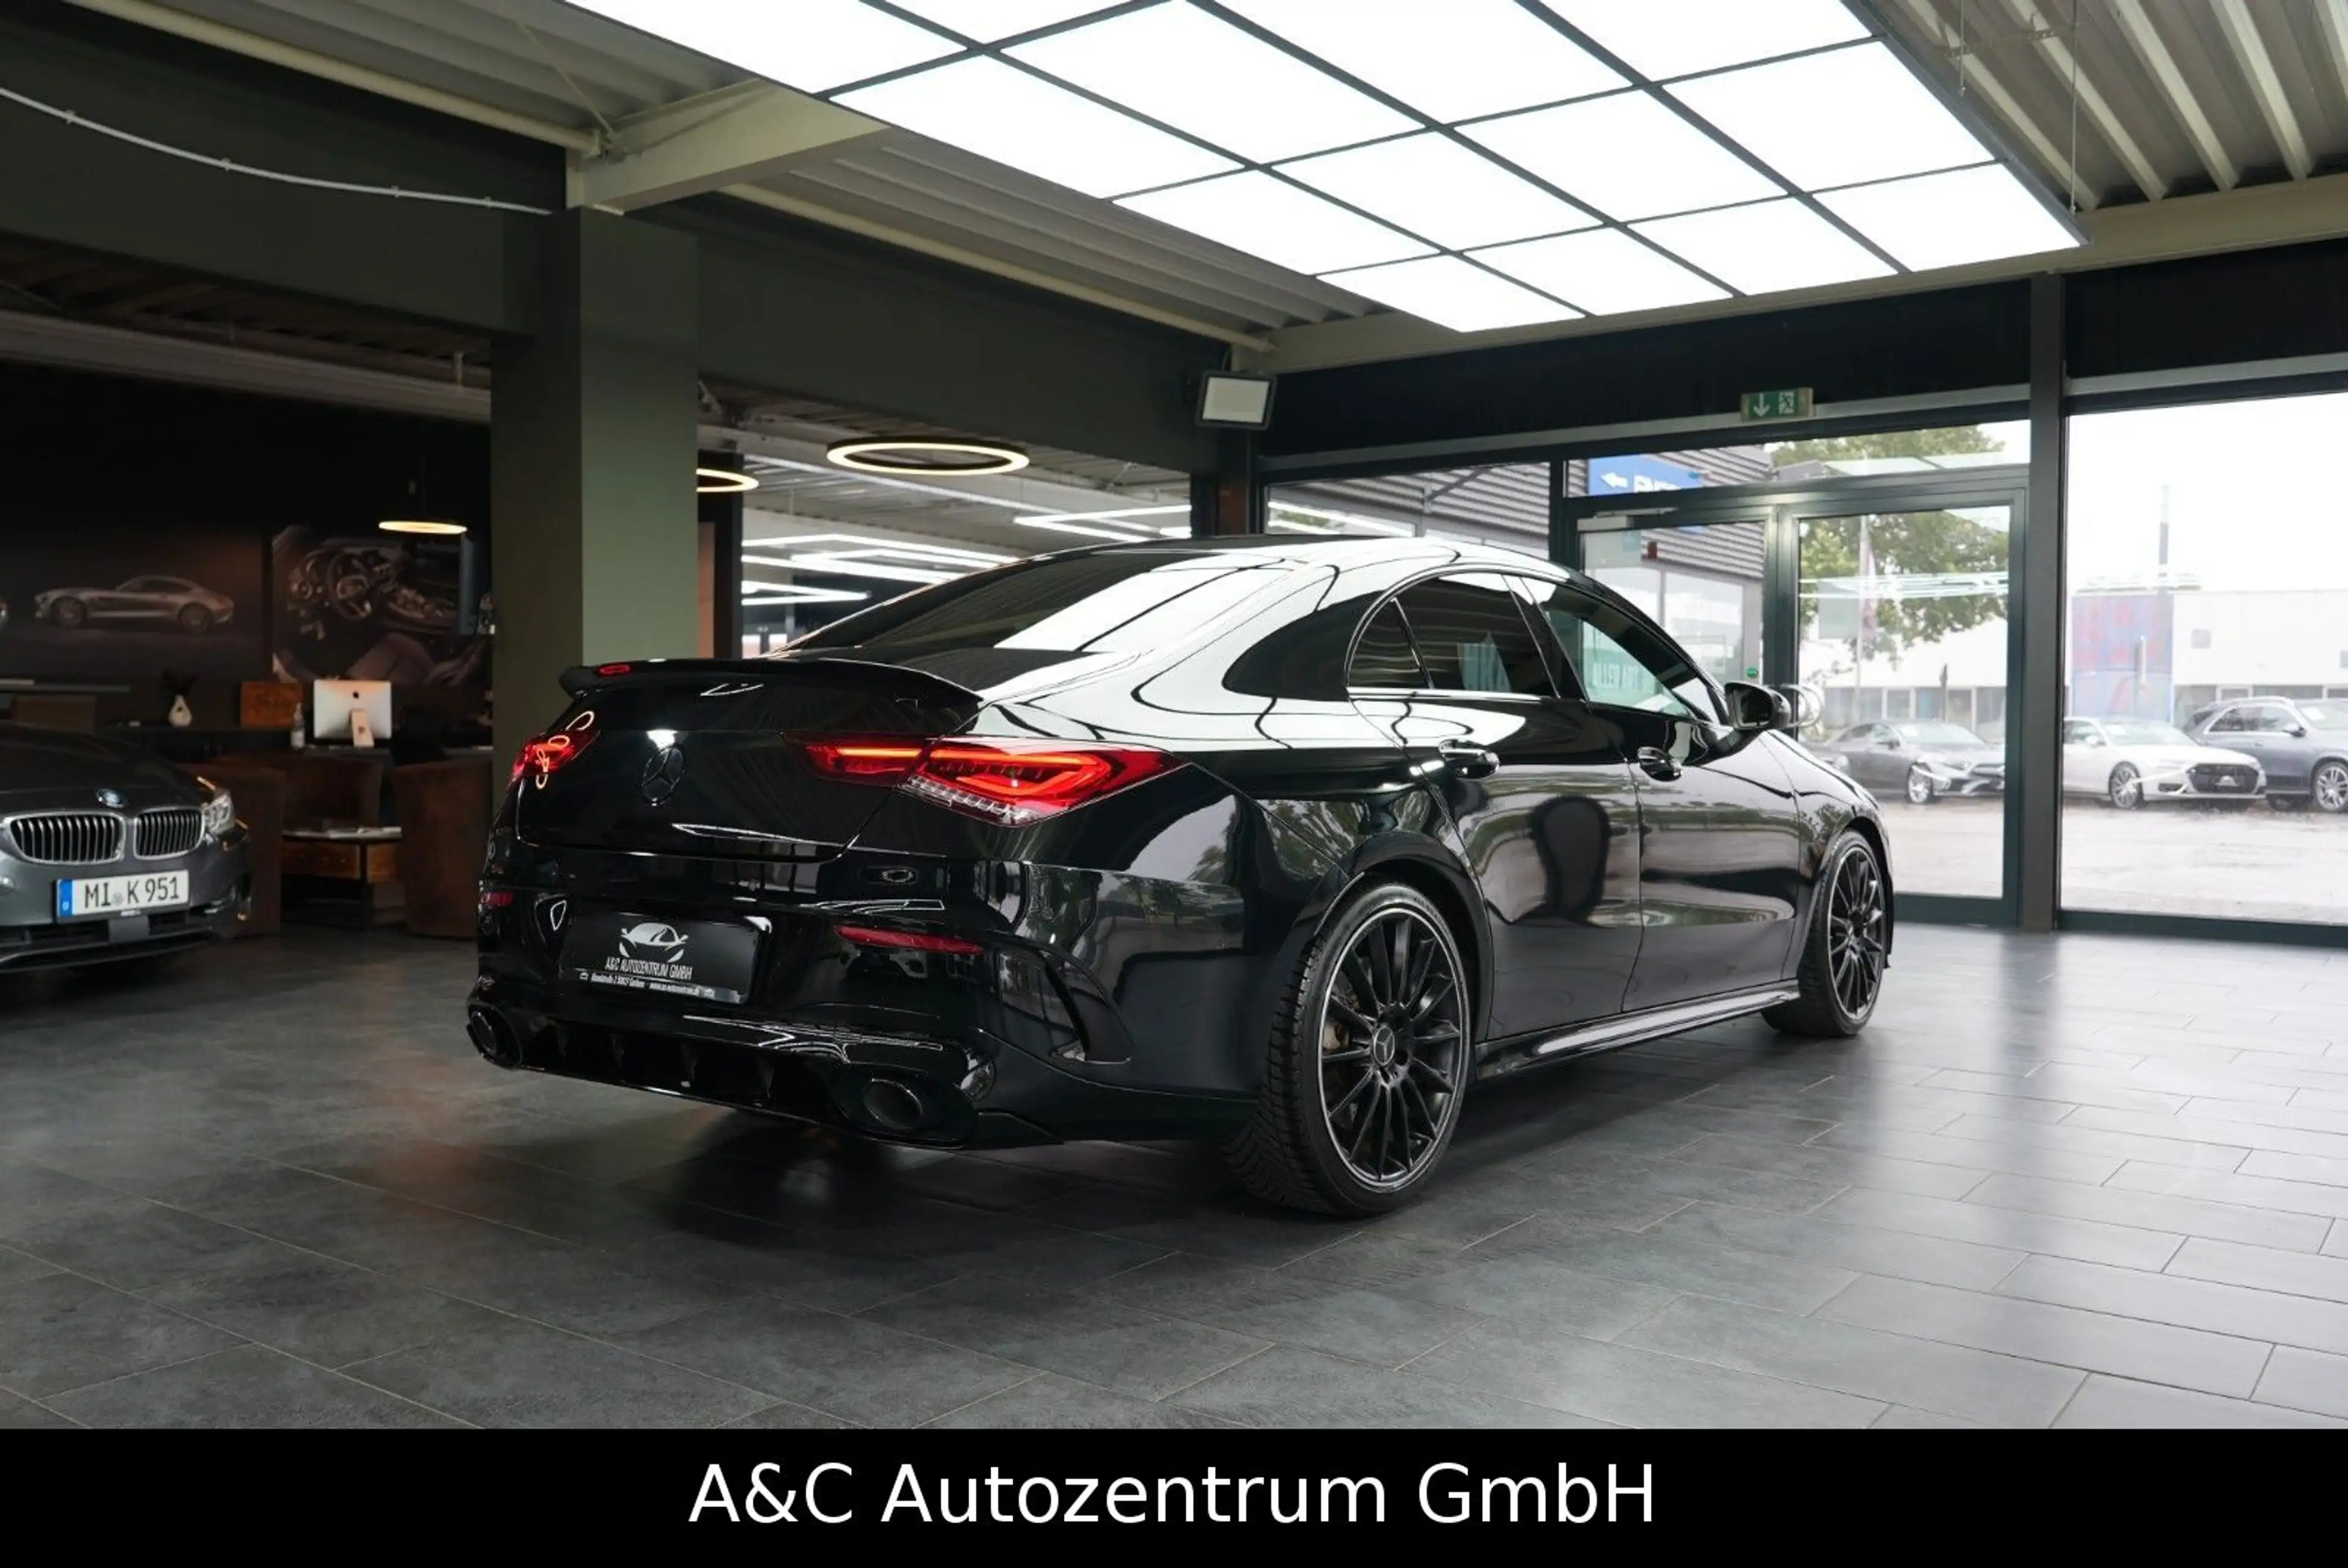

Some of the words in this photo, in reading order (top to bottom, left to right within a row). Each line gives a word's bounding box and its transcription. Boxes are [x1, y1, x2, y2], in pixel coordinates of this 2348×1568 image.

[84, 881, 111, 908] MI
[127, 880, 139, 904] K
[145, 877, 179, 902] 951
